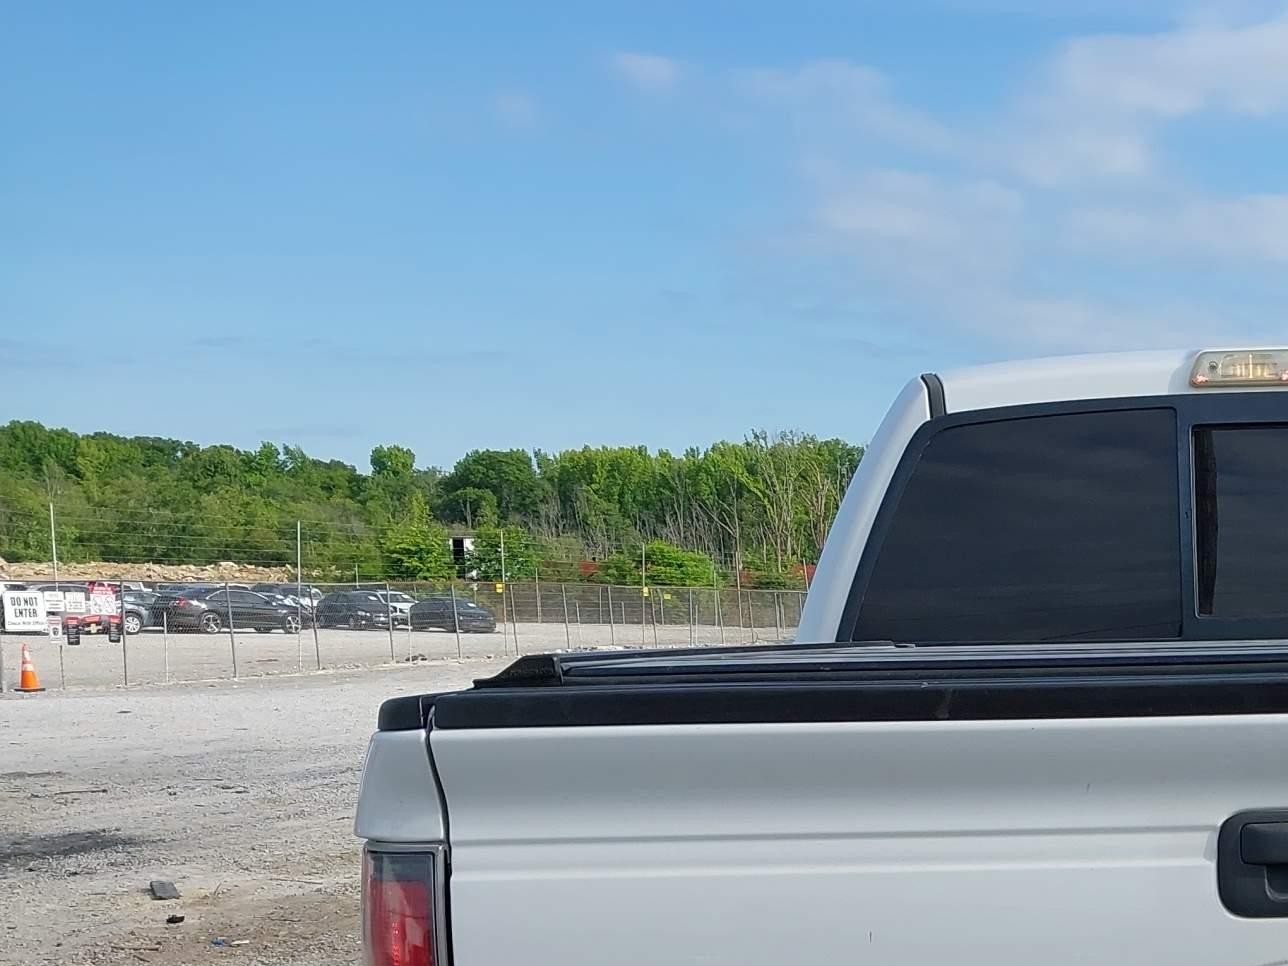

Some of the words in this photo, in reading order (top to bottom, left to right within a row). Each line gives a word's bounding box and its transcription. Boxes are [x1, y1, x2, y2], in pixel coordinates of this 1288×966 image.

[10, 596, 21, 606] DO
[23, 596, 38, 606] NOT
[14, 608, 38, 618] ENTER
